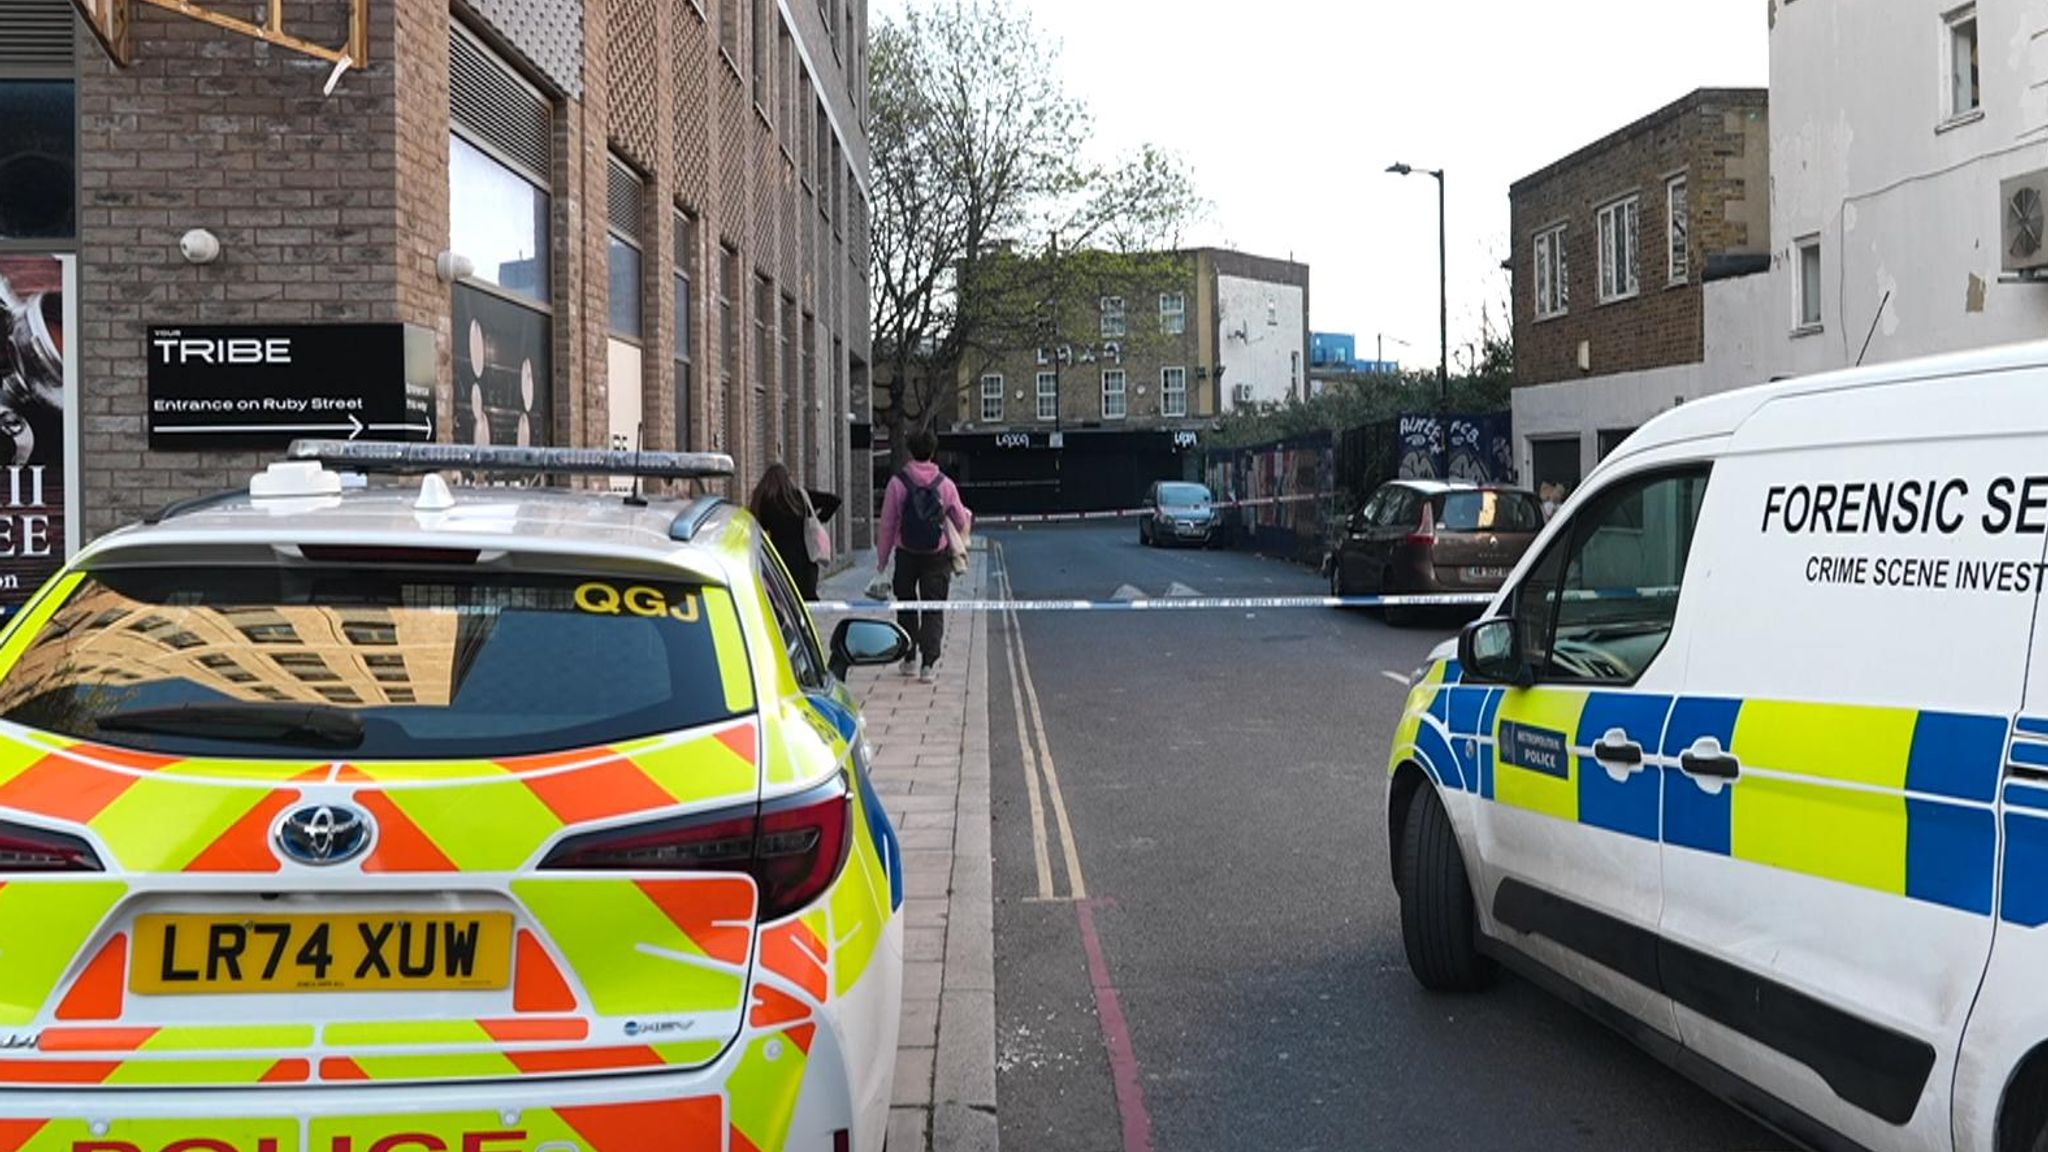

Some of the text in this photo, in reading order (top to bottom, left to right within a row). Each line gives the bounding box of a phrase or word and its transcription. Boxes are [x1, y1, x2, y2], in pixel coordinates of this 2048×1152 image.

[153, 338, 292, 364] TRIBE
[153, 396, 364, 412] Entrance on Ruby Street
[0, 464, 47, 508] II
[1761, 475, 2048, 535] FORENSIC SE
[1805, 555, 1869, 584] CRIME
[1872, 558, 1950, 588] SCENE
[574, 581, 700, 622] QGJ
[1523, 747, 1557, 769] POLICE
[160, 921, 480, 982] LR74 XUW
